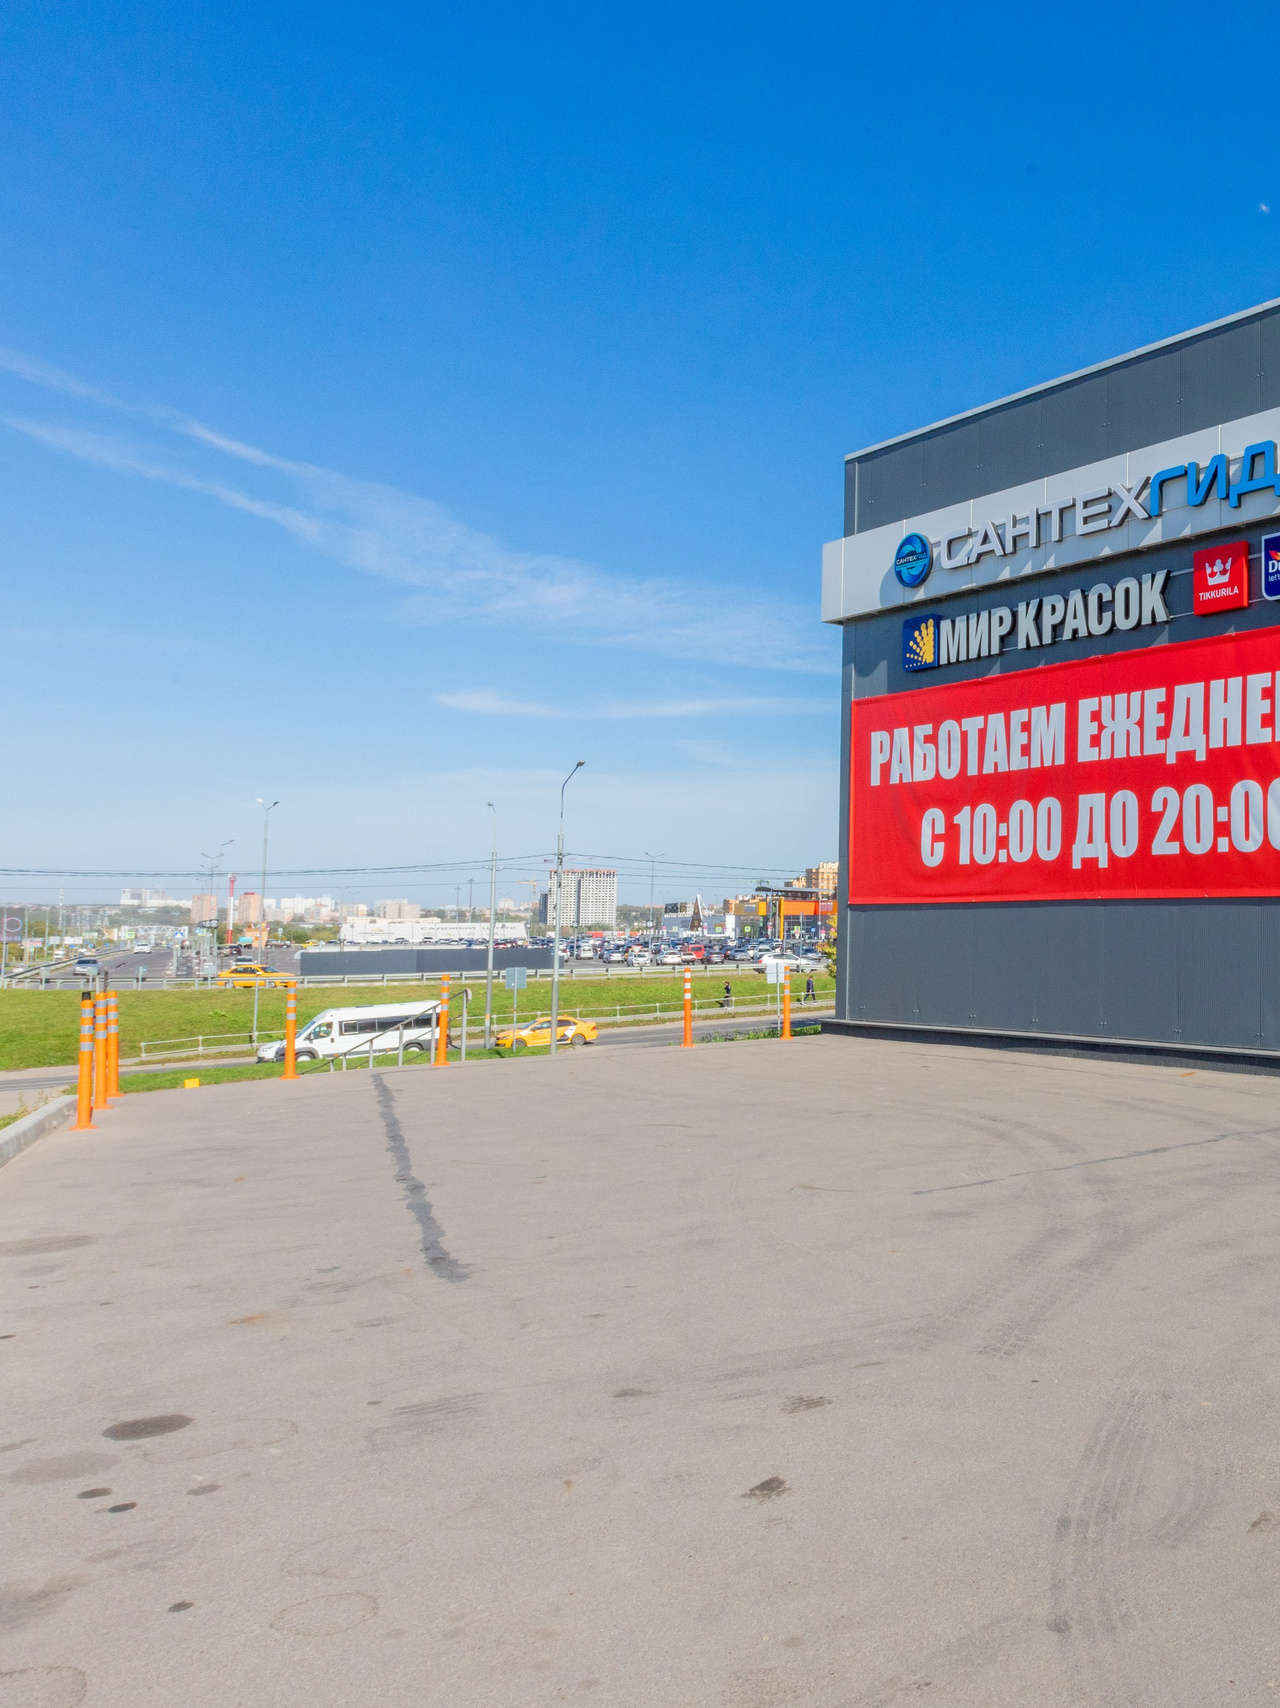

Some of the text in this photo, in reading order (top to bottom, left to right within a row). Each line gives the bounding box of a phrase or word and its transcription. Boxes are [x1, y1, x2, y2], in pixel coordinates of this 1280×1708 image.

[939, 569, 1171, 666] МИР КРАСОК
[1199, 585, 1239, 601] TIKKURILA
[870, 702, 1066, 787] РАБОТАЕМ
[920, 808, 945, 868] С
[953, 796, 1062, 866] 10:00
[1072, 789, 1139, 870] ДО
